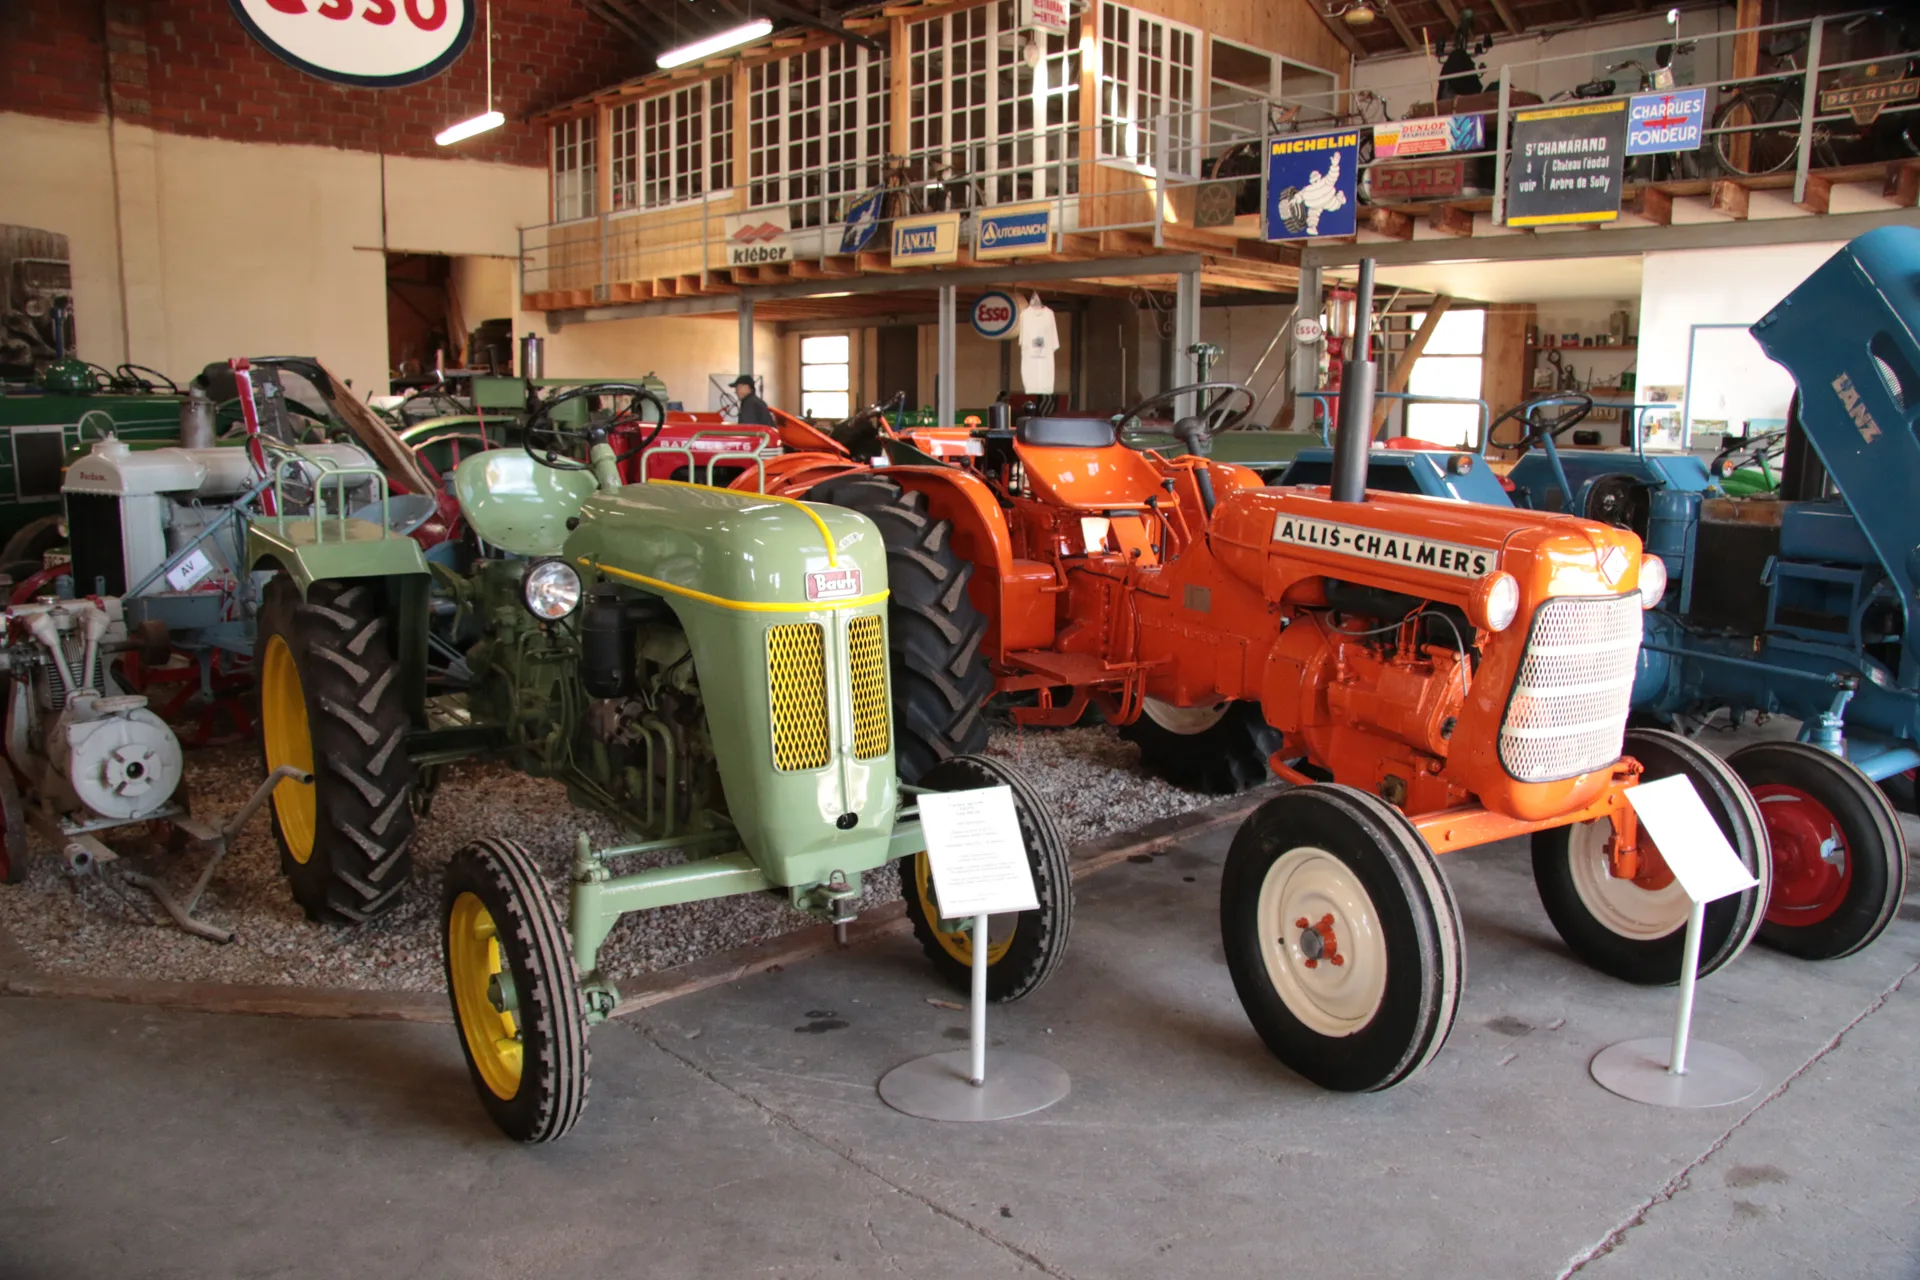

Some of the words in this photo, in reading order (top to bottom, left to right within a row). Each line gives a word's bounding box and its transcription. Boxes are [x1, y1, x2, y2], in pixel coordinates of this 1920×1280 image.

[1827, 83, 1915, 105] DEERING
[1402, 121, 1446, 135] DUNLOP
[1630, 125, 1698, 147] FONDEUR
[1272, 134, 1357, 155] MICHELIN
[1378, 166, 1456, 187] FAHR
[1519, 179, 1537, 193] voir
[1549, 178, 1574, 191] Arbre
[1577, 176, 1587, 189] de
[1590, 175, 1611, 194] Sully
[897, 229, 936, 256] LANCIA
[733, 246, 787, 264] kléber
[1831, 372, 1882, 444] LANZ
[1282, 521, 1487, 575] ALLIS-CHALMERS
[181, 561, 195, 577] AV
[813, 570, 858, 597] Bautz
